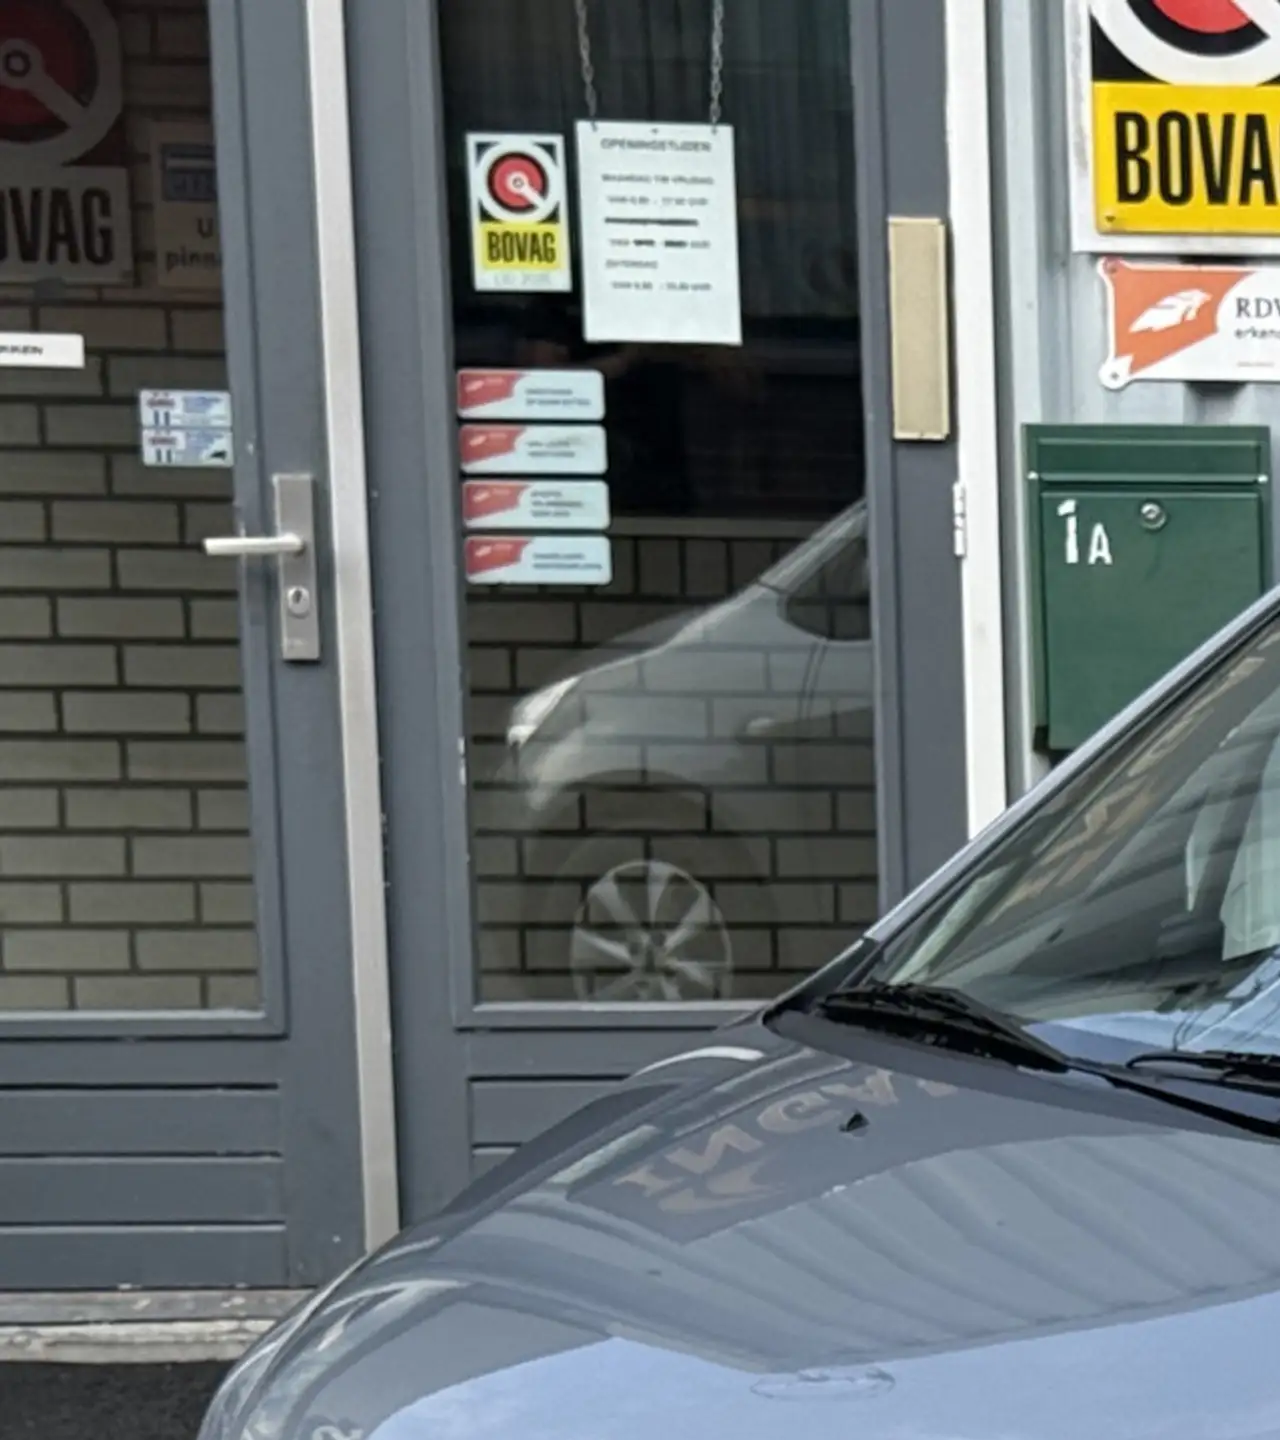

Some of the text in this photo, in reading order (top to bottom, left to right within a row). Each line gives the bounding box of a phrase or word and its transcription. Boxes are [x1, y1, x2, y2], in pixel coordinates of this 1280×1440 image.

[0, 186, 114, 266] VAG
[487, 230, 557, 263] BOVAG
[1056, 498, 1114, 566] 1A
